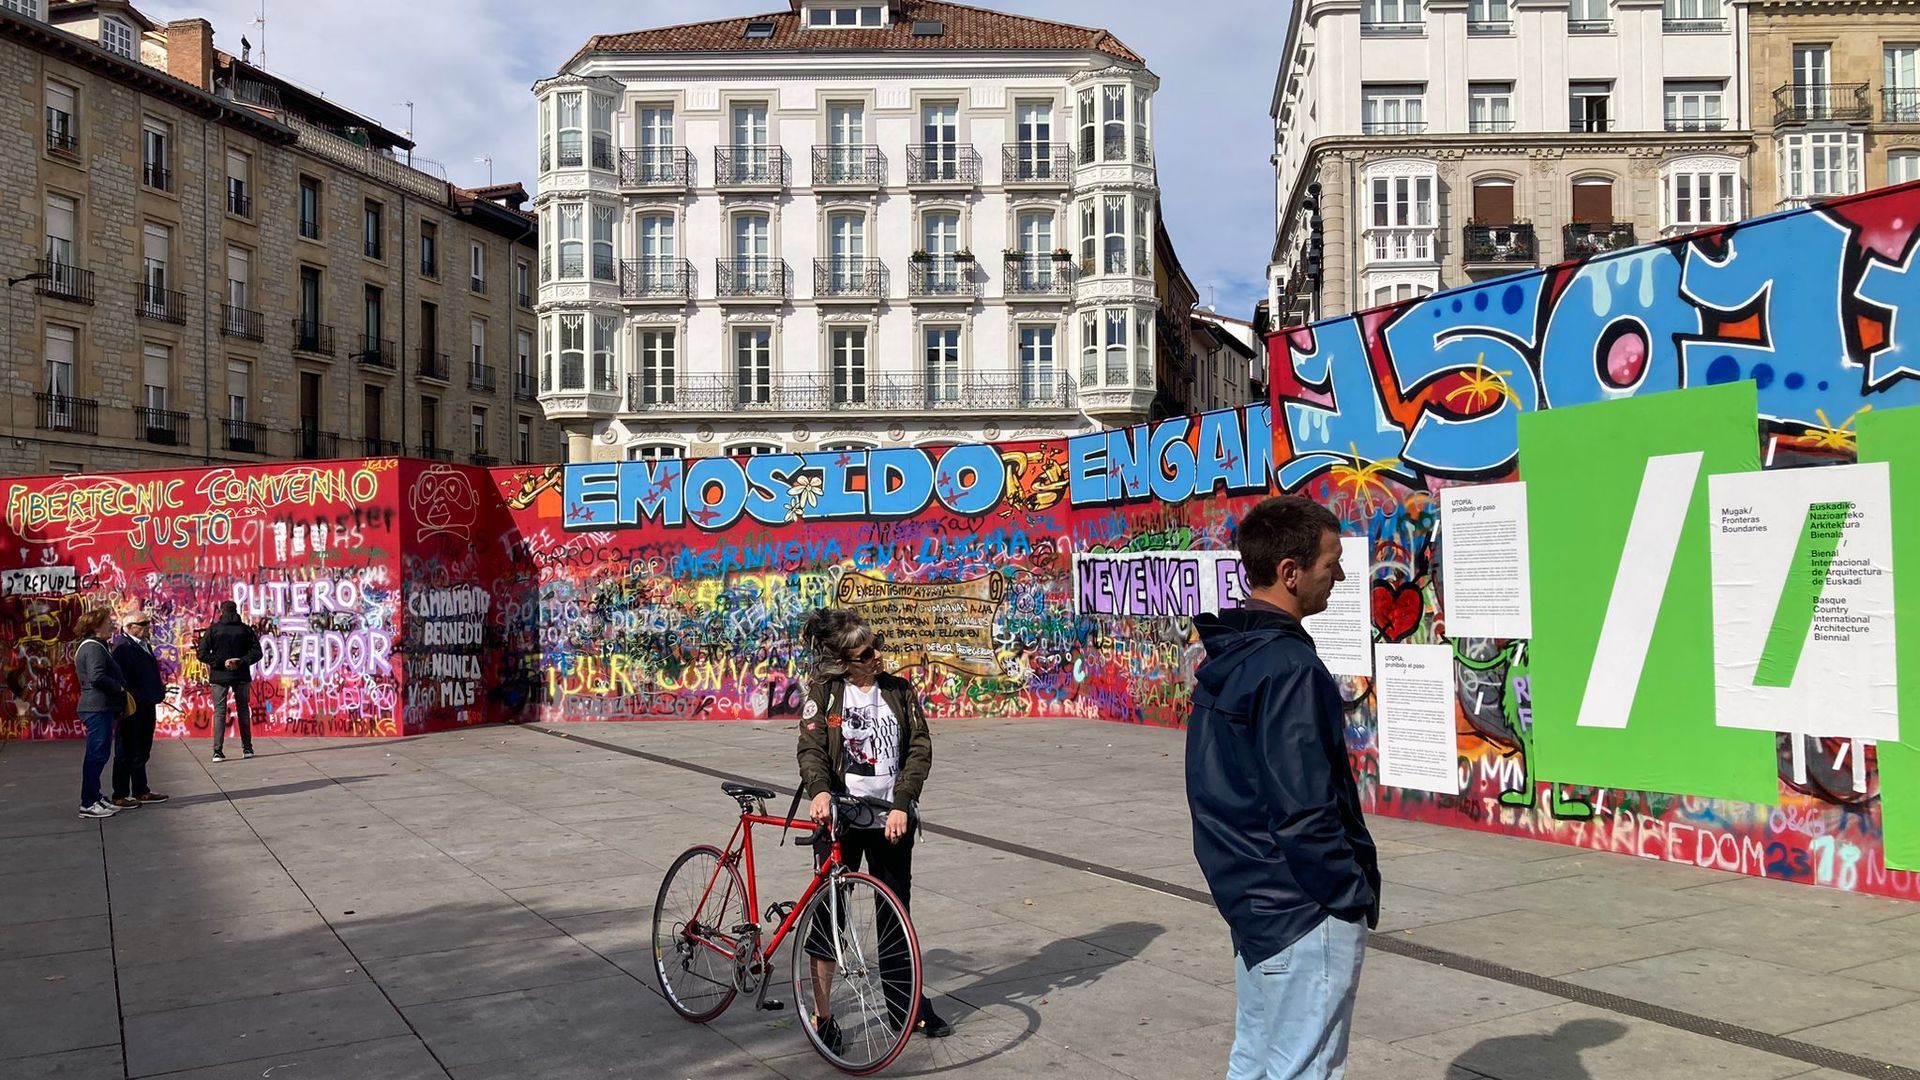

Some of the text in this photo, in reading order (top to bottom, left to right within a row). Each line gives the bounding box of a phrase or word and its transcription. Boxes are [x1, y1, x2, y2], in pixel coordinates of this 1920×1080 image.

[562, 444, 1006, 530] EMOSIDO
[6, 468, 378, 527] FIBERTECNIC CONVENIO
[1809, 502, 1857, 511] Euskadiko
[1721, 515, 1760, 524] Fronteras
[1809, 511, 1865, 520] Nazioarteko
[1721, 524, 1768, 533] Boundaries
[1810, 521, 1861, 530] Arkitektura
[128, 512, 232, 550] JUSTO
[1810, 530, 1844, 539] Bienala
[1811, 549, 1839, 558] Bienal
[1811, 558, 1871, 567] Internacional
[1811, 568, 1882, 577] de Arquitectura
[1811, 577, 1862, 586] de Euskadi
[1078, 556, 1201, 617] NEVENKA
[231, 581, 358, 617] PUTERO
[408, 586, 491, 618] CAMPAMENTO
[1812, 596, 1847, 606] Basque
[1813, 605, 1849, 614] Country
[1813, 615, 1871, 623] International
[1814, 624, 1870, 633] Architecture
[424, 621, 483, 646] BERNEDO
[1814, 633, 1850, 641] Biennial
[250, 630, 394, 681] OLADOR
[431, 653, 482, 680] NUNCA
[440, 681, 475, 708] MAS
[871, 714, 898, 729] MAK
[285, 717, 324, 736] PUTERO
